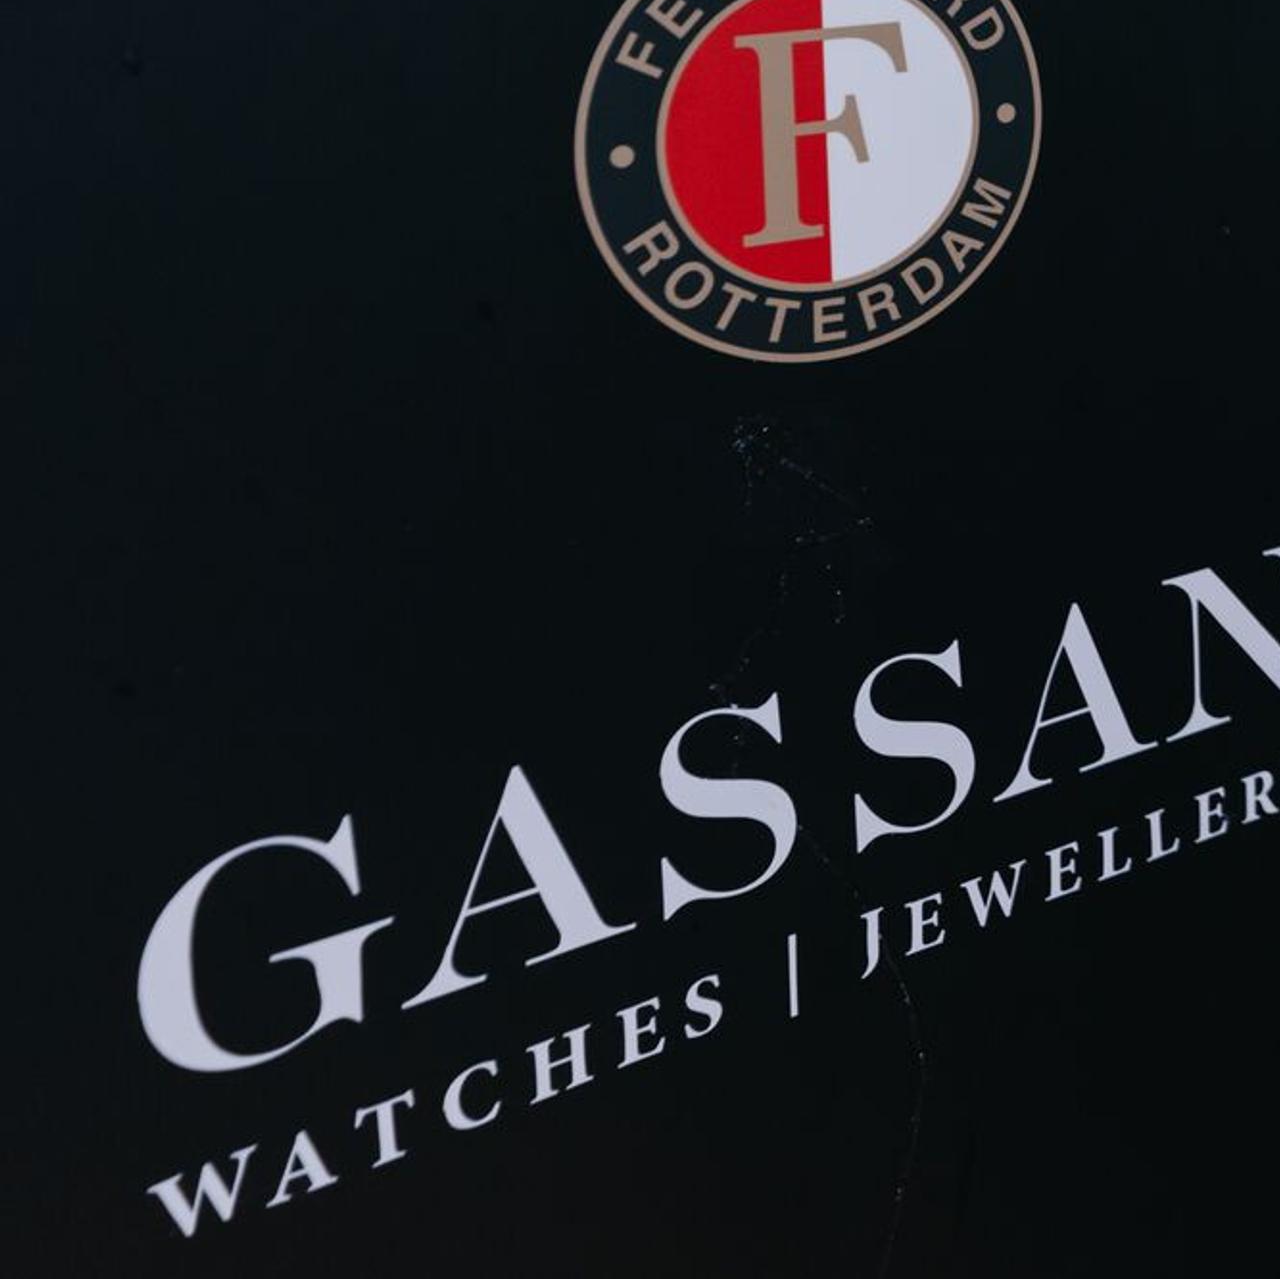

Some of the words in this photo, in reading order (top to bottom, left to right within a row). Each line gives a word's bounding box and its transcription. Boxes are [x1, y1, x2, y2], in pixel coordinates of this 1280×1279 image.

[733, 21, 909, 248] F
[622, 176, 1012, 344] ROTTERDAM
[146, 973, 724, 1237] WATCHES
